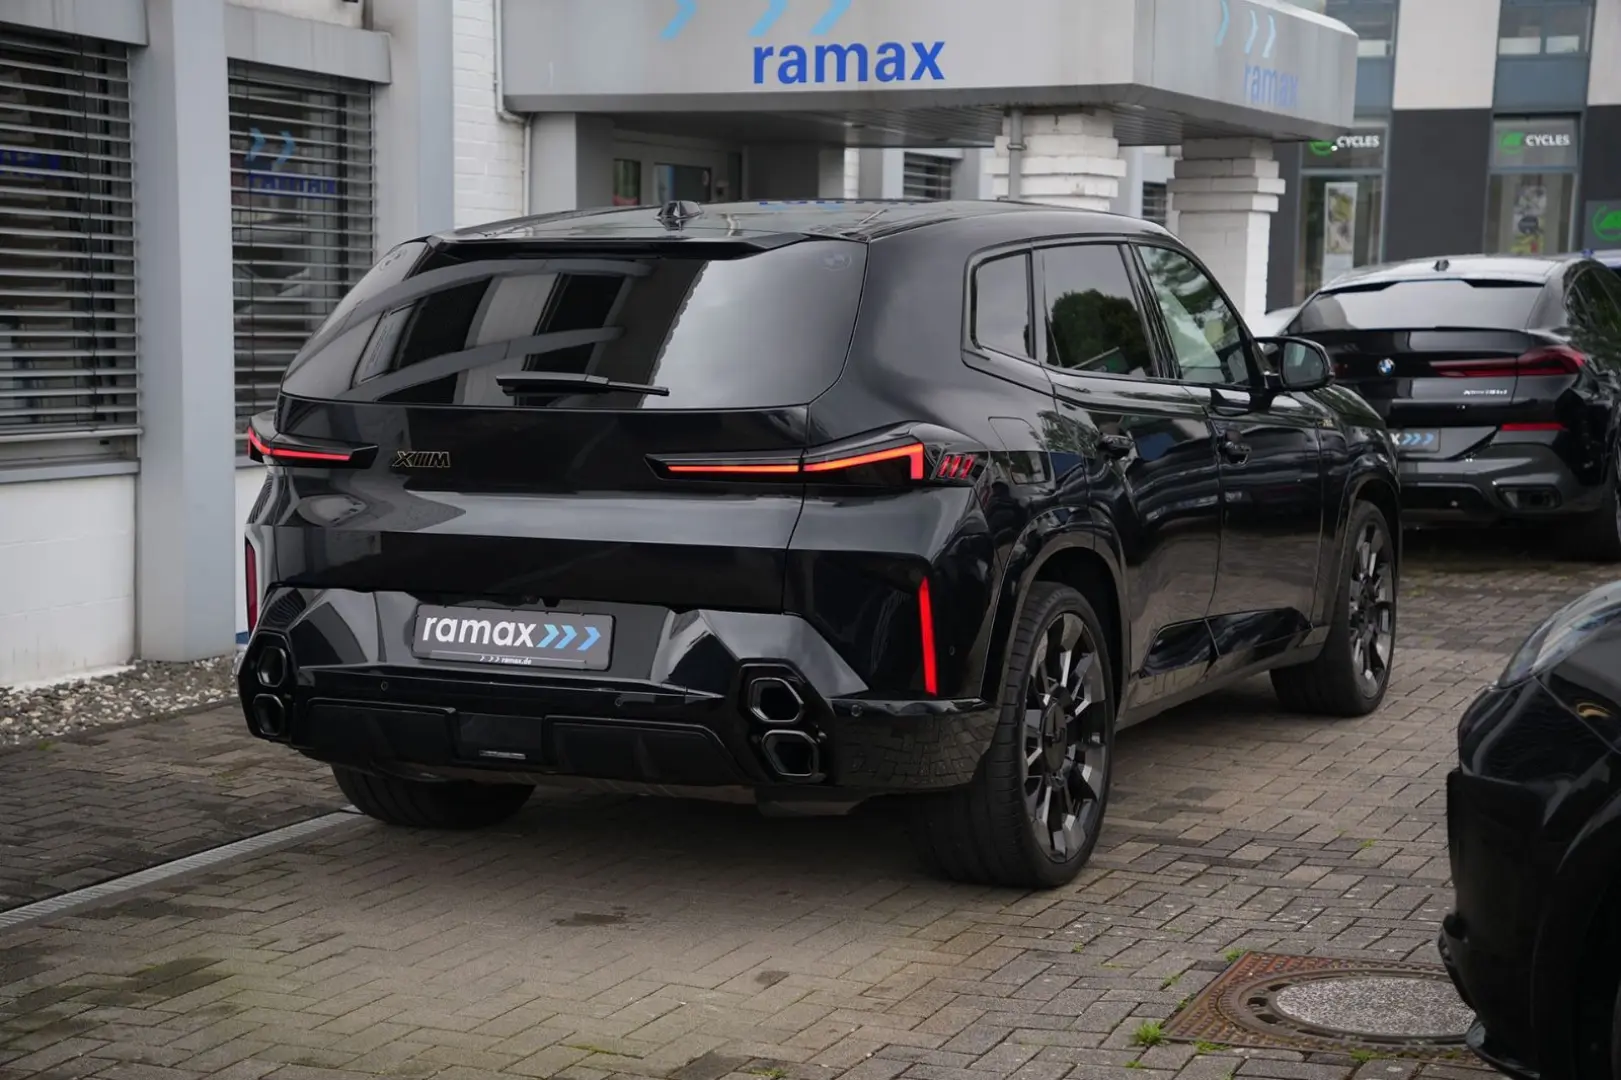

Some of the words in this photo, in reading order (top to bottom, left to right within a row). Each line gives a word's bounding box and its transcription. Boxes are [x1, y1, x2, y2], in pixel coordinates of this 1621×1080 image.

[754, 41, 945, 84] ramax
[1244, 64, 1298, 109] ramax
[1336, 135, 1380, 148] CYCLES
[1525, 134, 1571, 146] CYCLES
[422, 616, 537, 648] ramax
[501, 657, 532, 665] ramax.de
